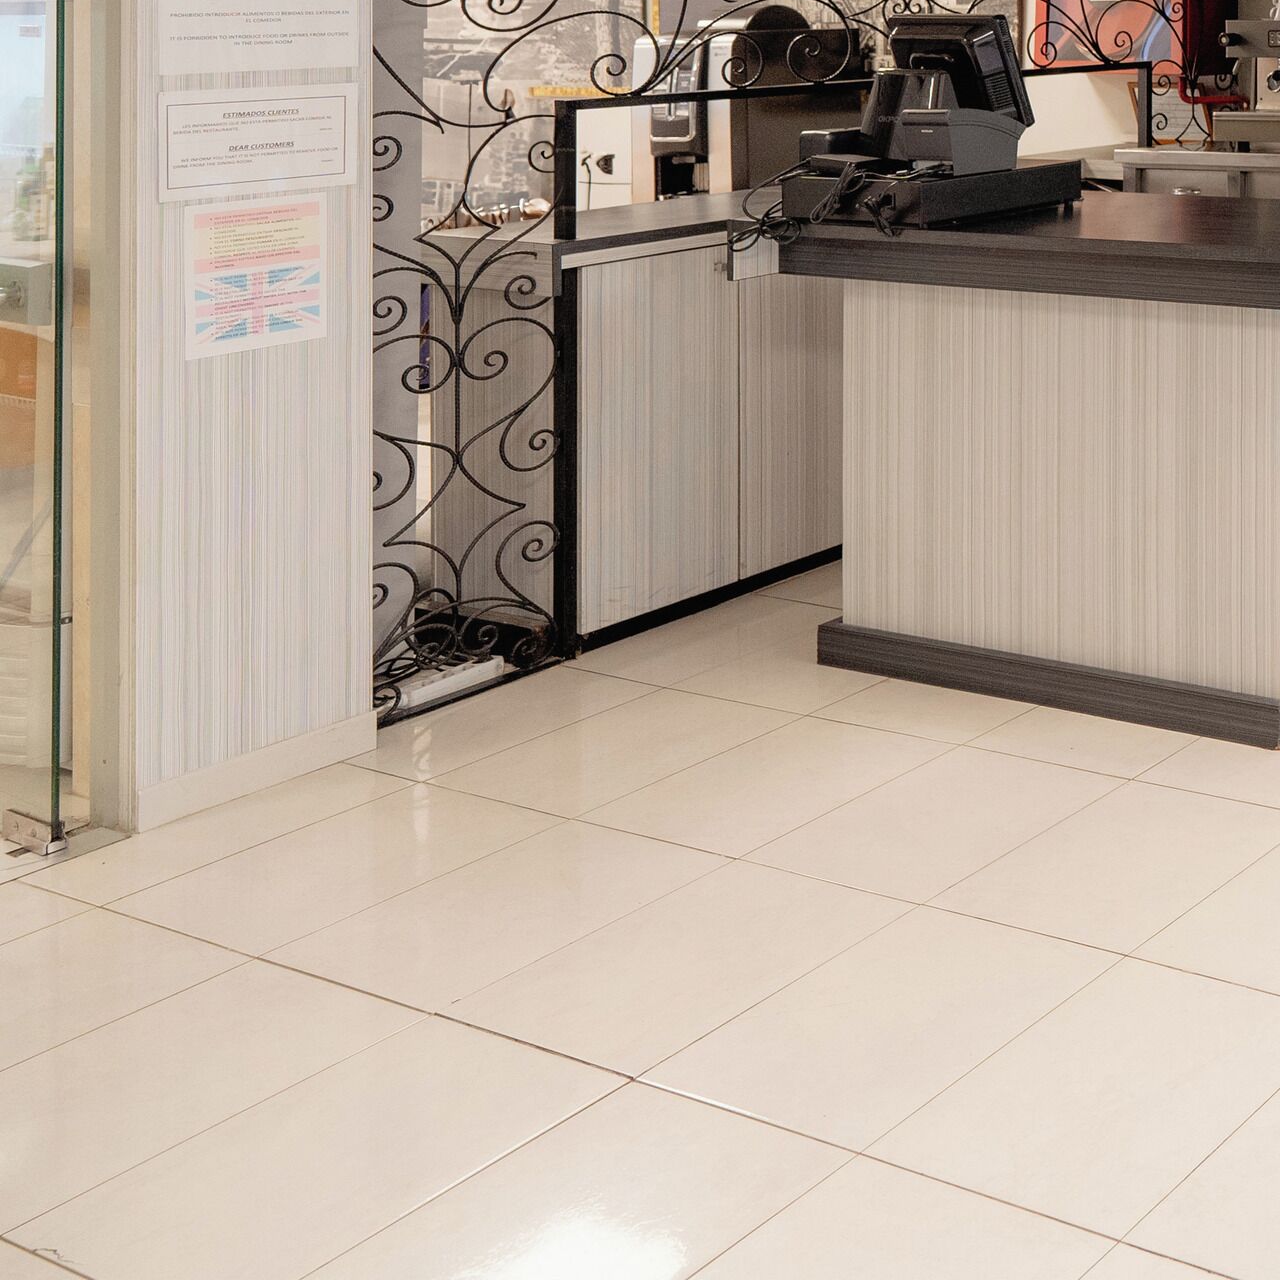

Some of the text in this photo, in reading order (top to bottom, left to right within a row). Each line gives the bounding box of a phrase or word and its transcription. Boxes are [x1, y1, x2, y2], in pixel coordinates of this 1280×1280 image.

[223, 108, 299, 119] ESTIMADOS CLIENTES
[251, 141, 294, 150] CUSTOMERS
